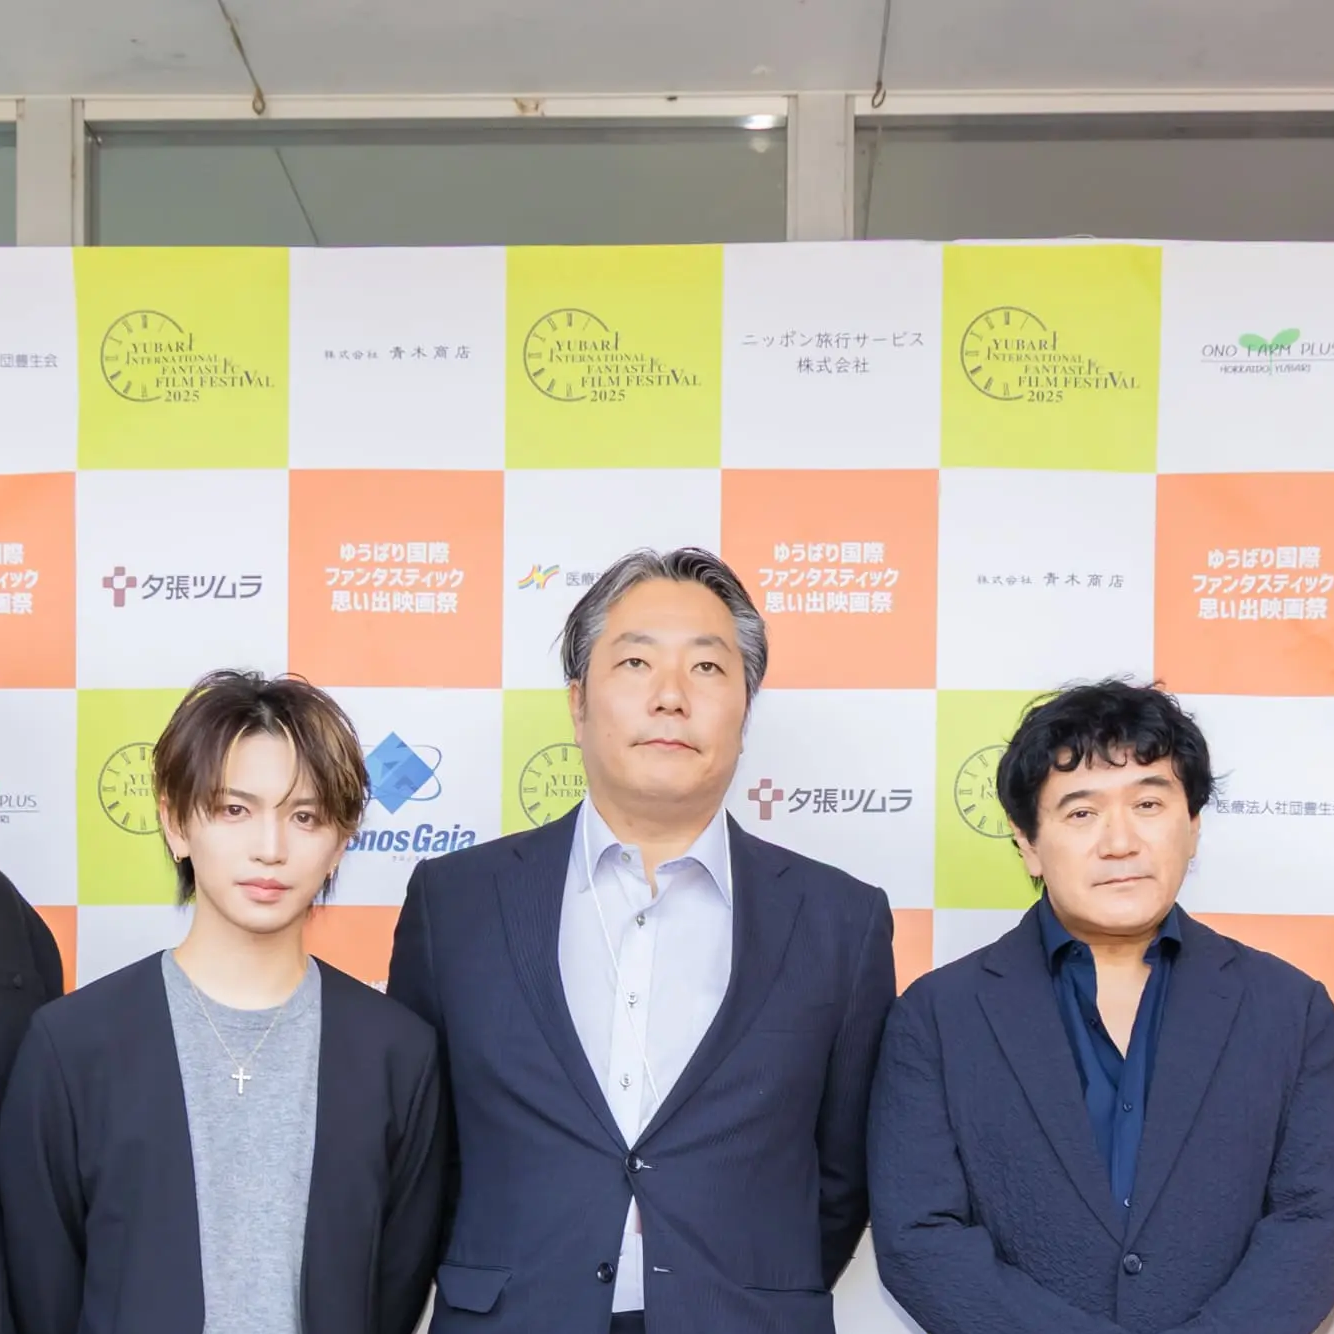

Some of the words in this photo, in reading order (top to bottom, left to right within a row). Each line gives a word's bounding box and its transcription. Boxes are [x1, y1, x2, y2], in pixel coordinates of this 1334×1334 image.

[131, 333, 194, 353] YUBARI
[555, 331, 619, 351] YUBARI
[992, 331, 1056, 351] YUBARI
[1201, 344, 1238, 357] ONO
[1246, 343, 1291, 357] FARM
[126, 352, 218, 365] INTERNATIONAL
[550, 348, 646, 363] INTERNATIONAL
[988, 347, 1085, 363] INTERNATIONAL
[797, 356, 870, 375] 株式会社
[155, 376, 195, 388] FILM
[200, 370, 274, 388] FESTIVAL
[581, 376, 620, 388] FILM
[626, 369, 702, 387] FESTIVAL
[1019, 376, 1058, 388] FILM
[1064, 371, 1140, 389] FESTIVAL
[164, 390, 200, 402] 2025
[590, 389, 626, 402] 2025
[1027, 390, 1063, 403] 2025
[340, 541, 450, 564] ゆうばり国際
[773, 541, 885, 564] ゆうばり国際
[1207, 546, 1321, 569] ゆうばり国際
[141, 574, 263, 600] 夕張ツムラ
[324, 567, 465, 588] ファンタスティック
[758, 567, 900, 588] ファンタスティック
[1192, 573, 1334, 595] ファンタスティック
[331, 590, 459, 613] 思い出映画祭
[765, 591, 893, 614] 思い出映画祭
[1198, 597, 1329, 621] 思い出映画祭
[0, 794, 38, 808] PLUS
[788, 788, 913, 814] 夕張ツムラ
